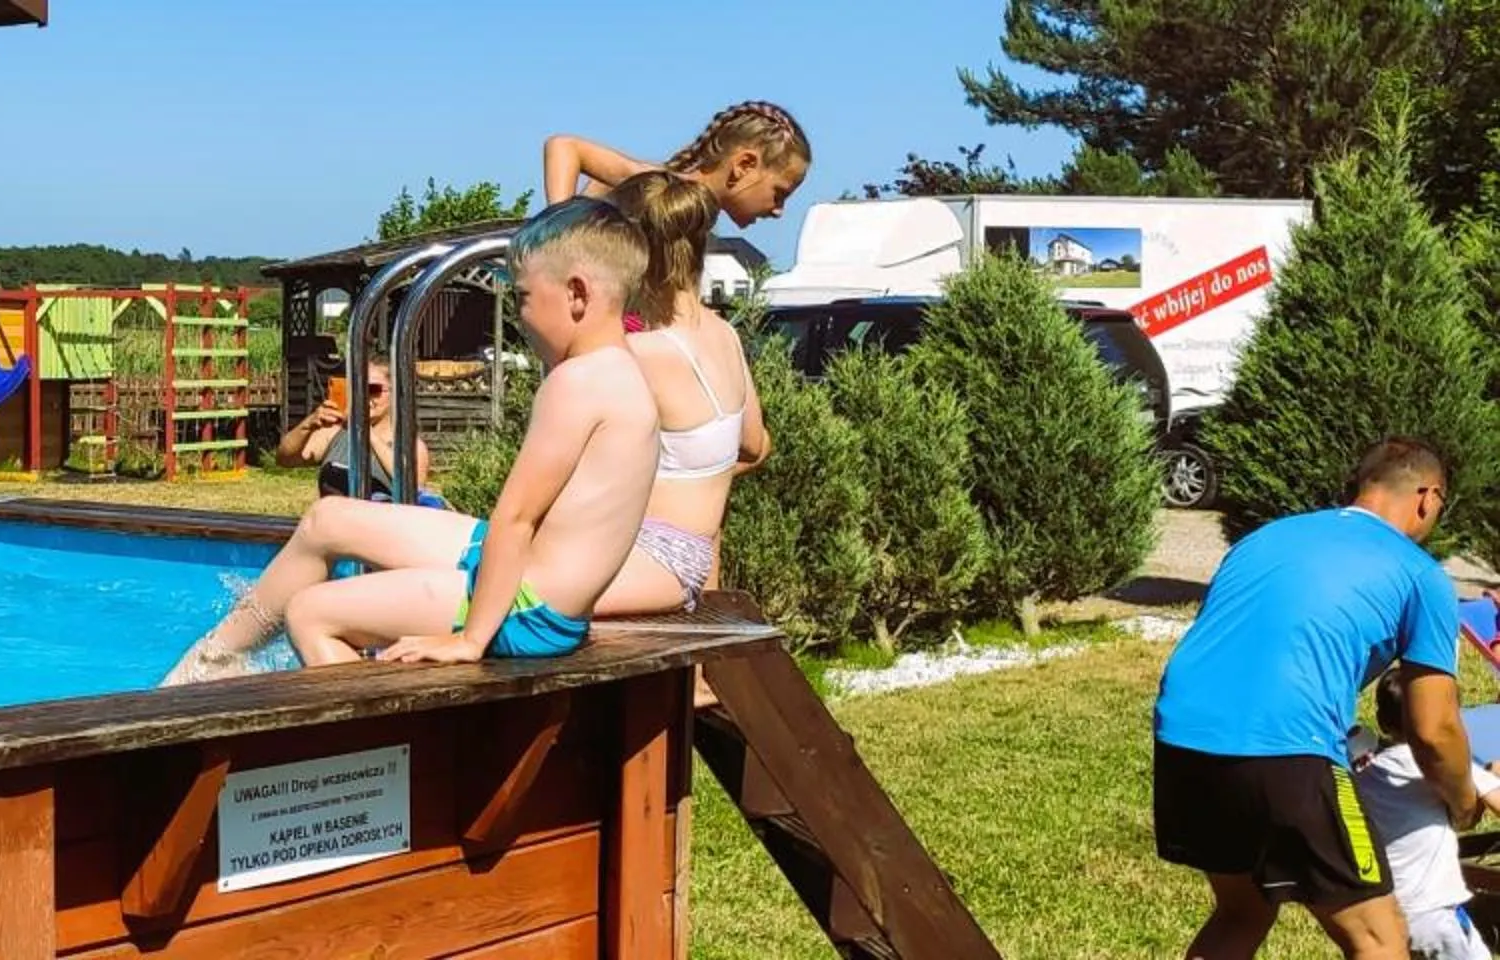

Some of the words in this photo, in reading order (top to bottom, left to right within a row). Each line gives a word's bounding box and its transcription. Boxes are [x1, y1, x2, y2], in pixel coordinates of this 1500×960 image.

[1211, 270, 1233, 295] do
[1236, 256, 1267, 285] nos
[233, 780, 289, 803] UWAGA!!!
[291, 775, 319, 794] Drogi
[269, 824, 309, 845] KĄPIEL
[312, 822, 322, 836] W
[325, 811, 371, 834] BASENIE
[230, 853, 271, 873] TYLKO
[273, 848, 298, 866] POD
[341, 823, 403, 849] DOROSŁYCH
